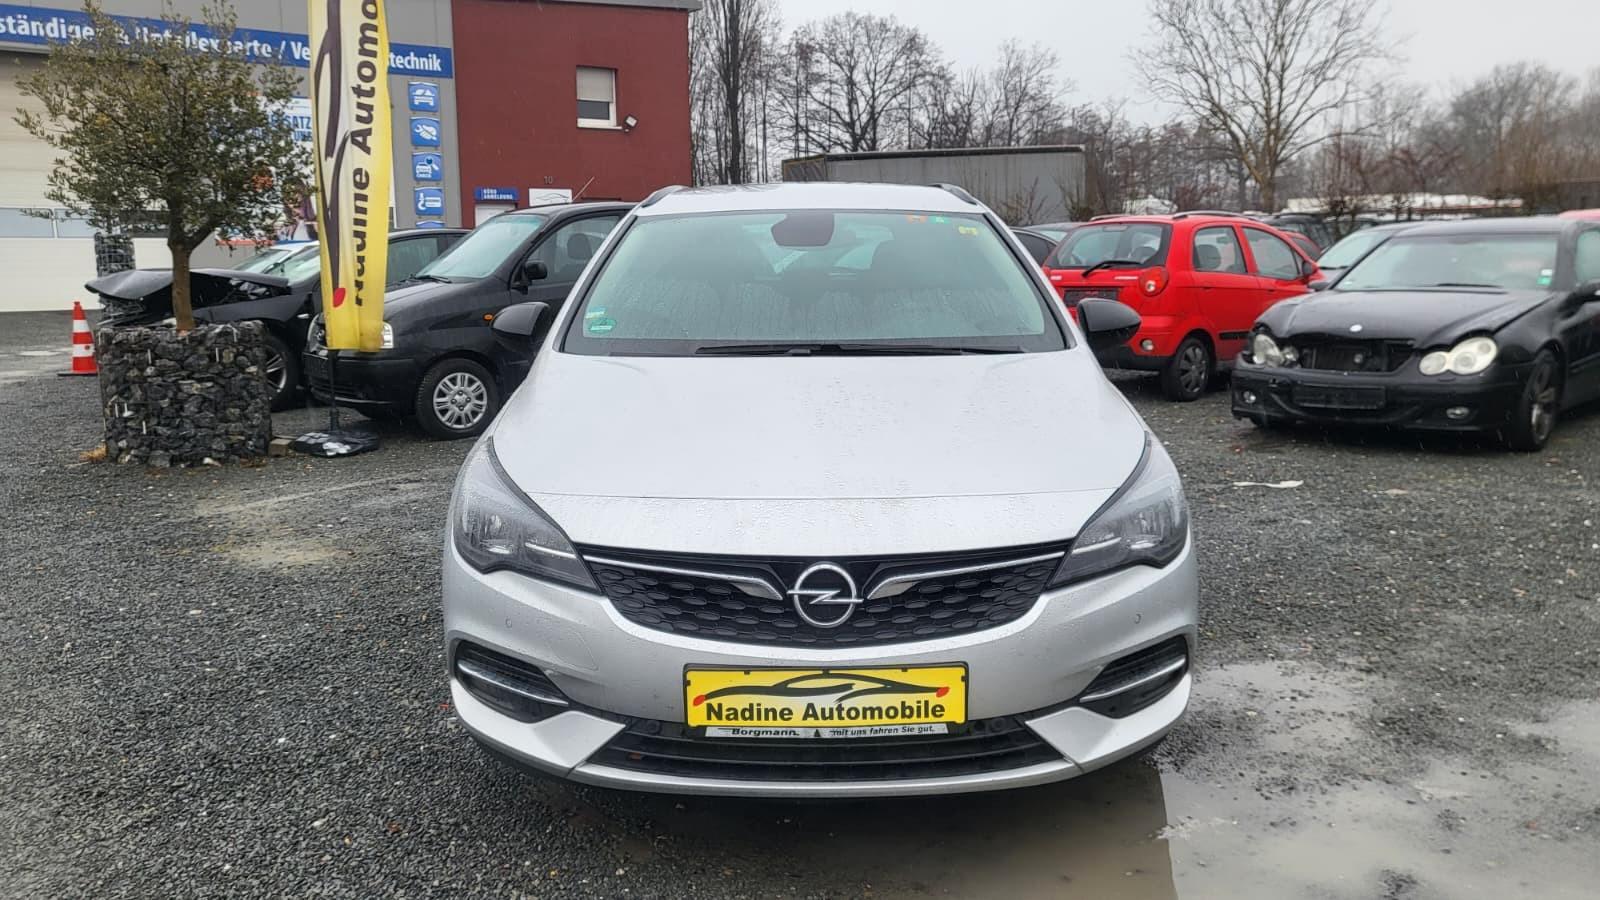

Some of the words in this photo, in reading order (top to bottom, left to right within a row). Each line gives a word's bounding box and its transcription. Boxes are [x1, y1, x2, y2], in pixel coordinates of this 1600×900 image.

[544, 176, 553, 184] 10
[706, 702, 793, 722] Nadine
[802, 701, 945, 721] Automobile
[870, 727, 899, 735] fahren
